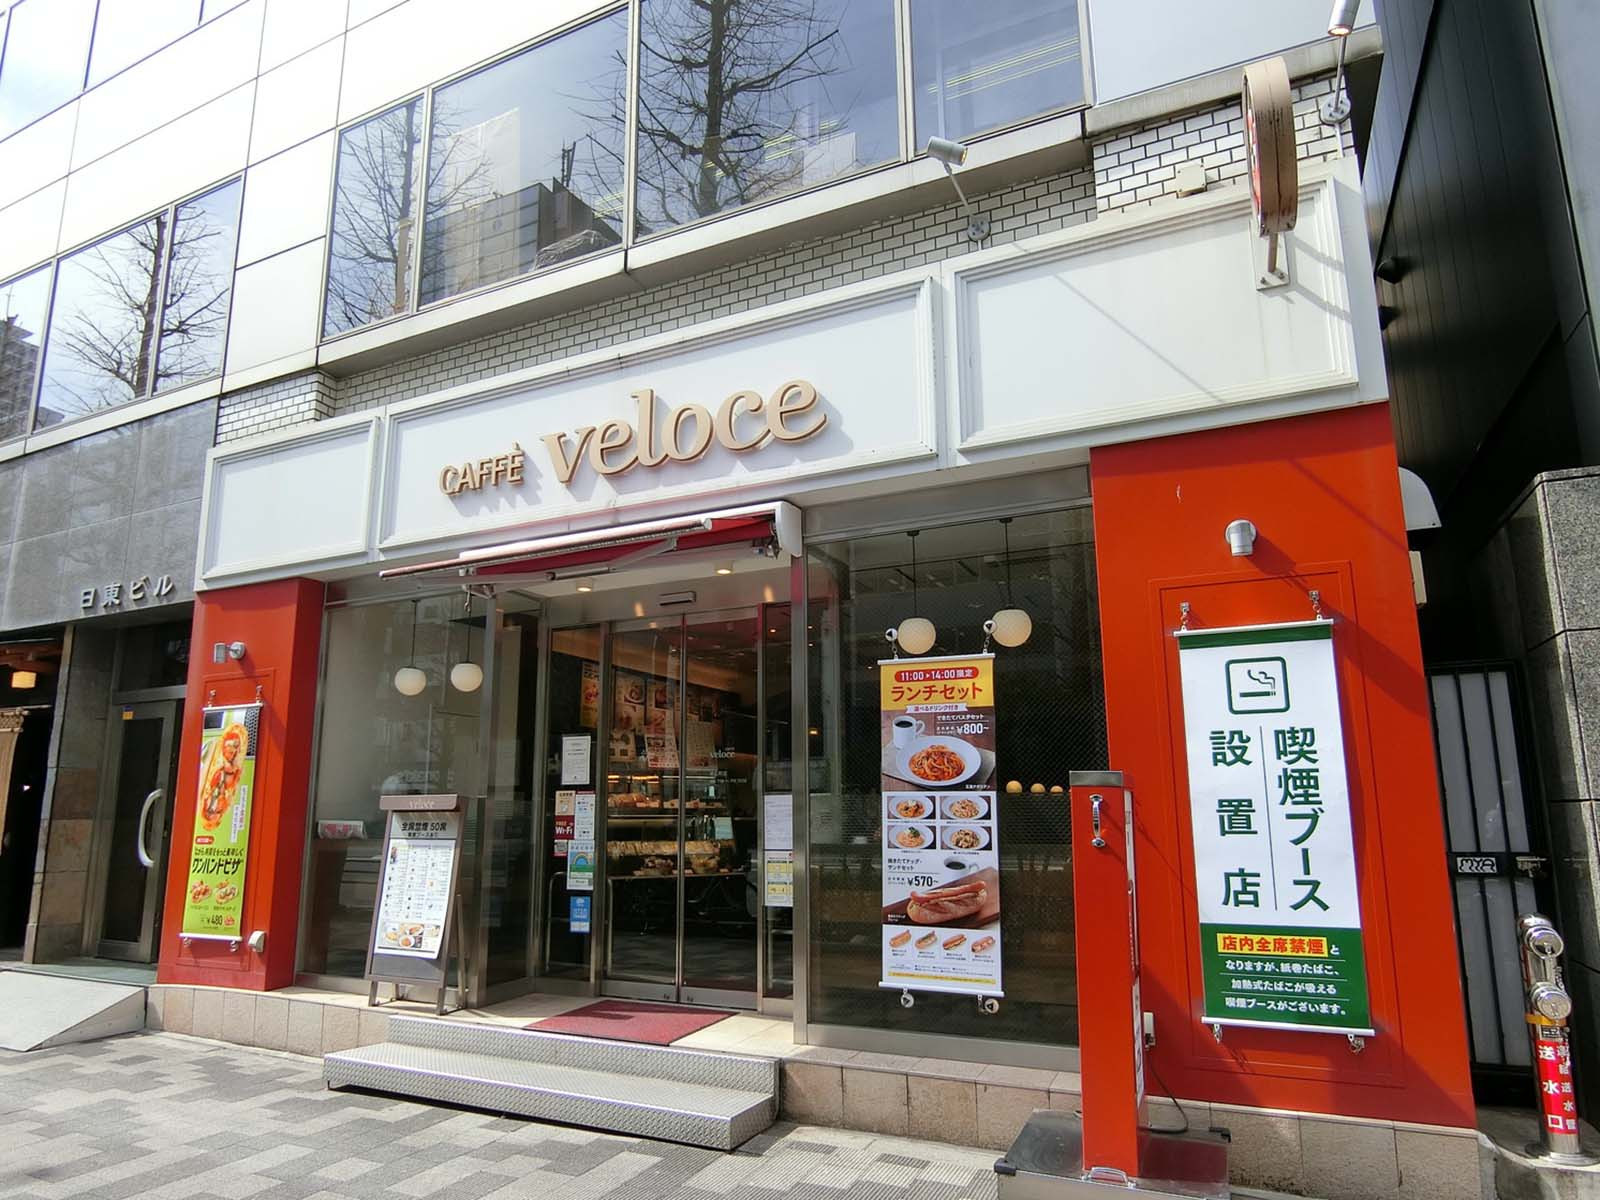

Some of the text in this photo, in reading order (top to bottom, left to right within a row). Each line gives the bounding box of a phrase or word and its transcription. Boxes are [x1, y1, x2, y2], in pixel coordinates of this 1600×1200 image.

[438, 379, 827, 496] CAFFÈ veloce
[80, 574, 174, 608] 日東ビル
[901, 670, 924, 681] 11:00
[891, 682, 983, 702] ランチセット
[1209, 730, 1261, 908] 設置店
[1273, 726, 1330, 912] 喫煙ブース
[1225, 959, 1339, 976] なりますが、紙巻たばこ、
[1231, 978, 1337, 995] 加熱式たばこが吸える
[1225, 997, 1346, 1016] 喫煙ブースがございます。
[1538, 1045, 1564, 1129] 送水口
